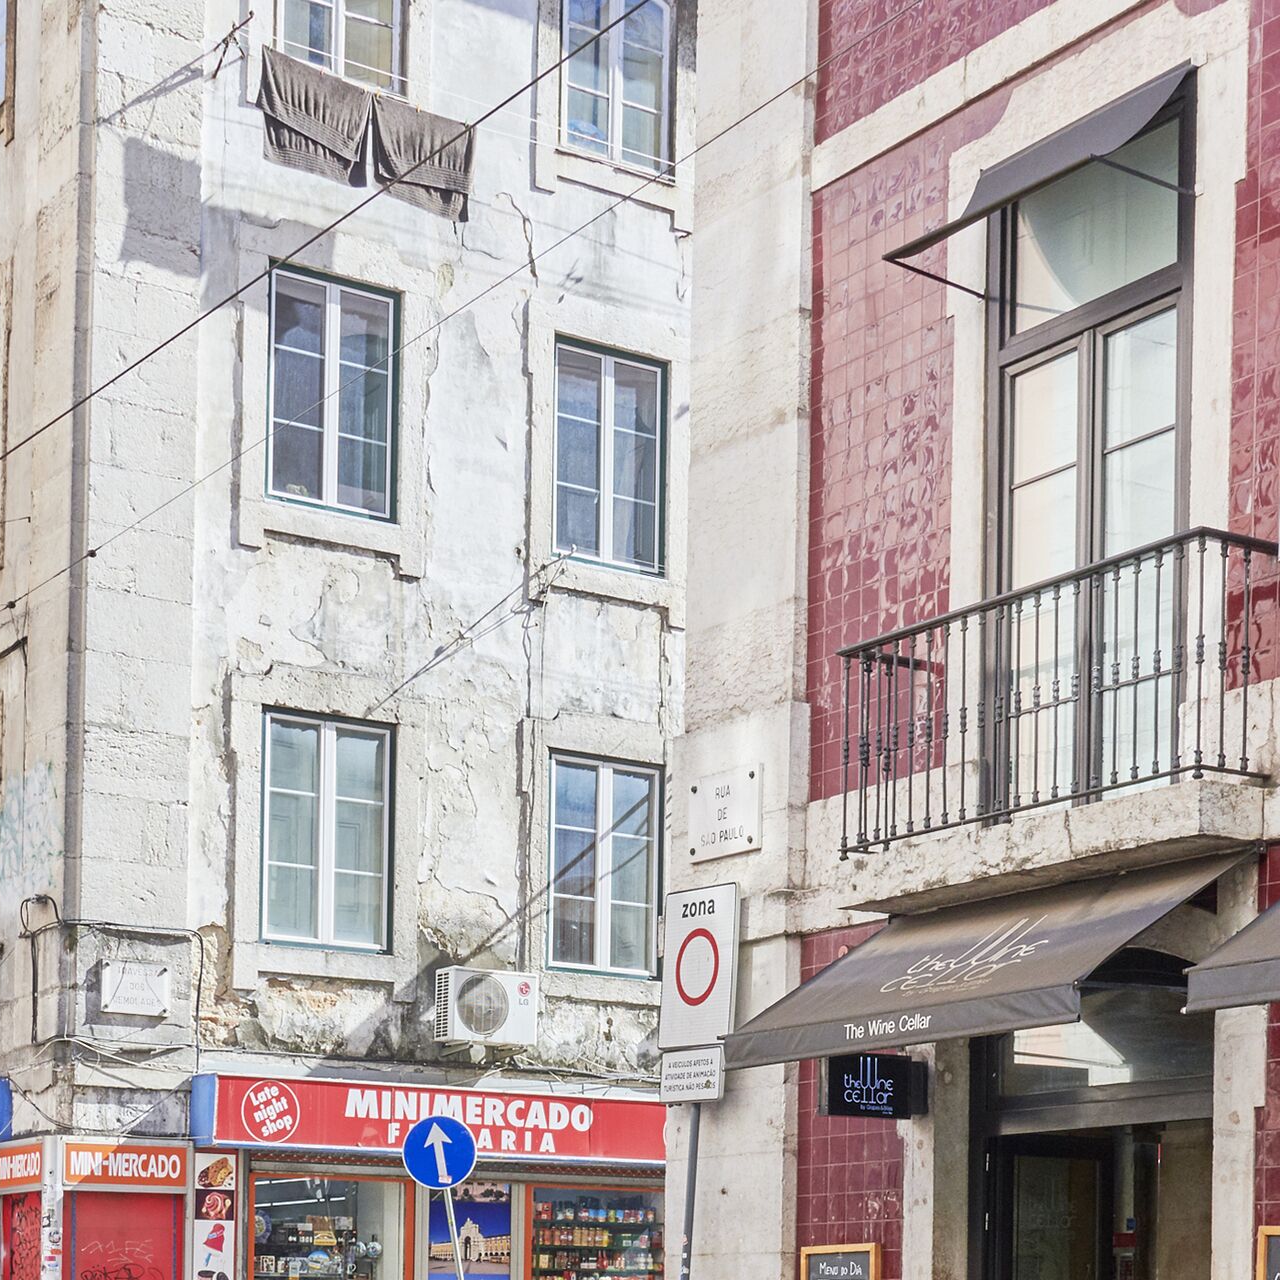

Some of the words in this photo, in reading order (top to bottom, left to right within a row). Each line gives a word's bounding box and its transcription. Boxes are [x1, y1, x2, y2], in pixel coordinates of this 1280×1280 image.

[715, 785, 731, 799] RUA
[717, 807, 728, 820] DE
[719, 825, 744, 842] PAULO
[682, 898, 715, 918] zona
[518, 998, 529, 1006] LG
[844, 1023, 864, 1040] The
[868, 1018, 895, 1036] Wine
[899, 1014, 932, 1032] Cellar
[249, 1086, 279, 1106] Late
[253, 1096, 288, 1123] night
[345, 1089, 593, 1131] MINIMERCADO
[261, 1115, 293, 1137] shop
[0, 1151, 41, 1180] MINI-MERCADO
[70, 1151, 181, 1179] MINI-MERCADO
